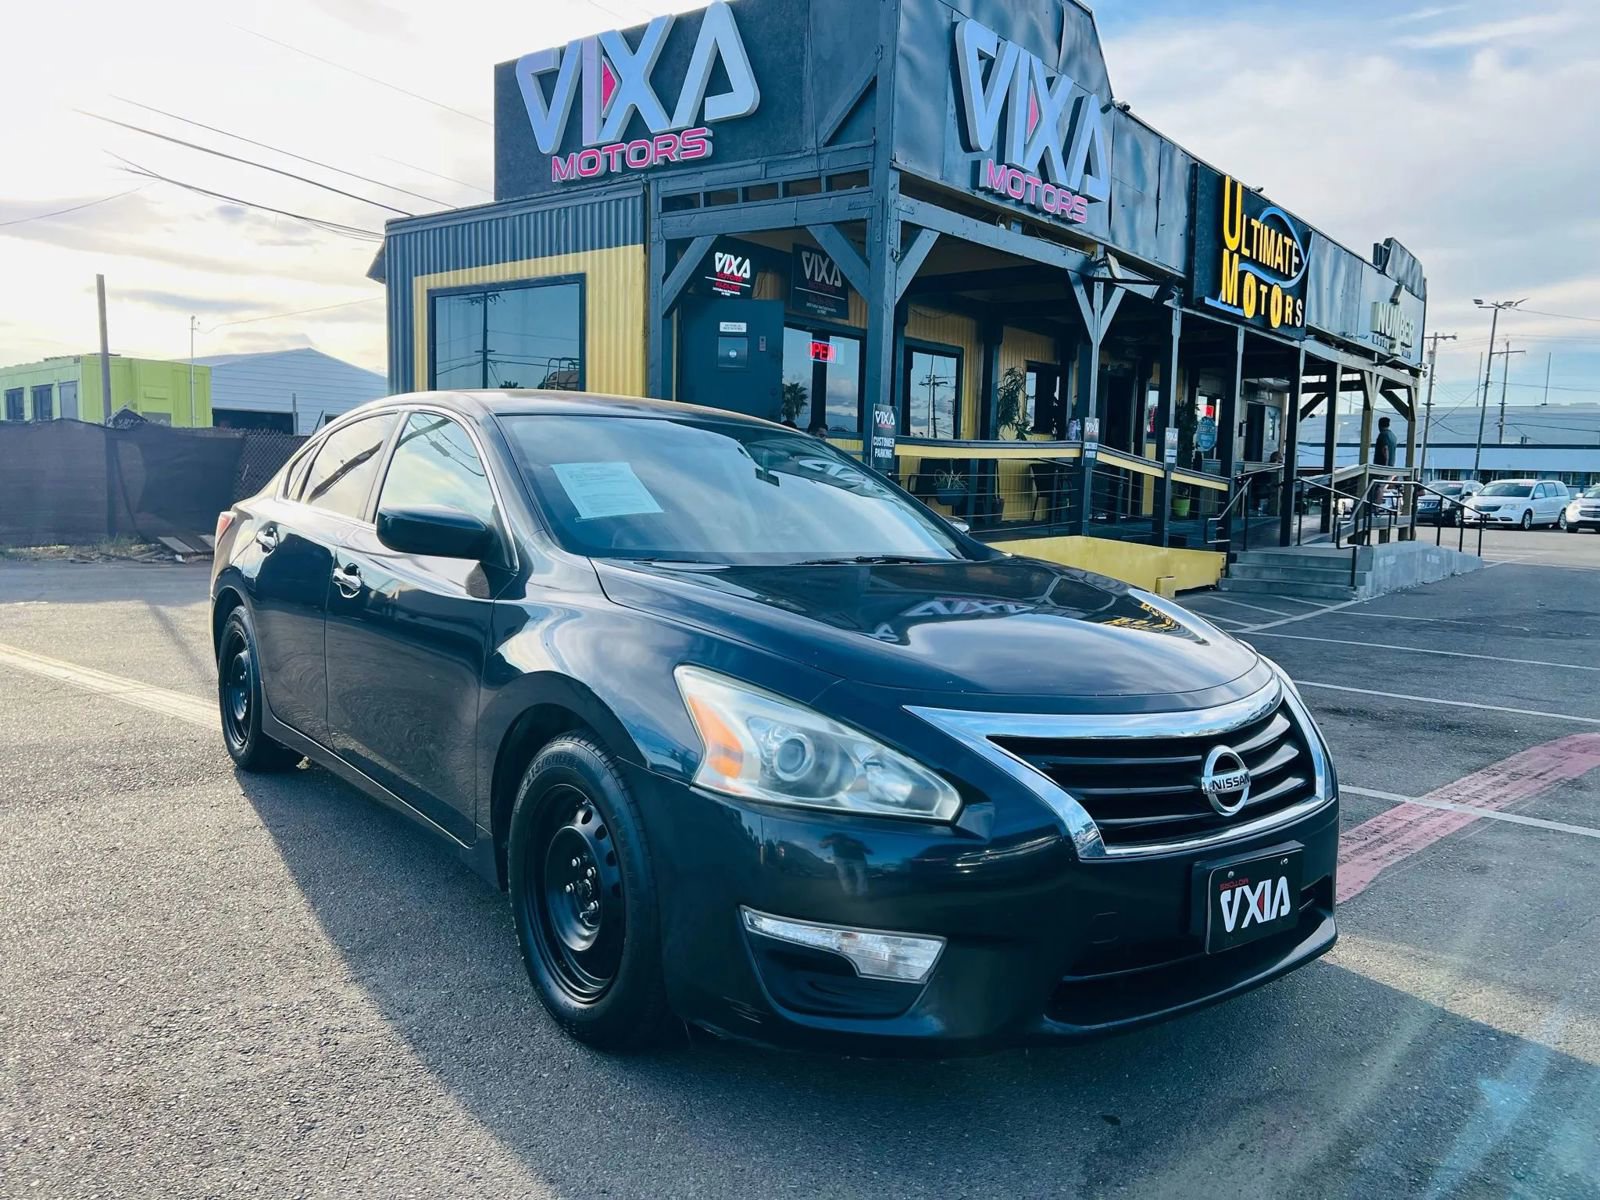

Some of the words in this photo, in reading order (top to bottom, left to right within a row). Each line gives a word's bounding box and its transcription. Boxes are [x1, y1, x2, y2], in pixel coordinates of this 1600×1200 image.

[516, 1, 760, 154] VIXA
[955, 18, 1109, 201] VIXA
[552, 127, 713, 182] MOTORS
[986, 159, 1088, 224] MOTORS
[1223, 175, 1301, 277] ULTIMATE
[715, 252, 750, 278] VIXA
[802, 251, 842, 287] VIXA
[1221, 248, 1303, 329] MOTORS
[808, 342, 836, 362] PEN
[875, 410, 895, 425] VIXA
[1212, 771, 1250, 790] NISSAN
